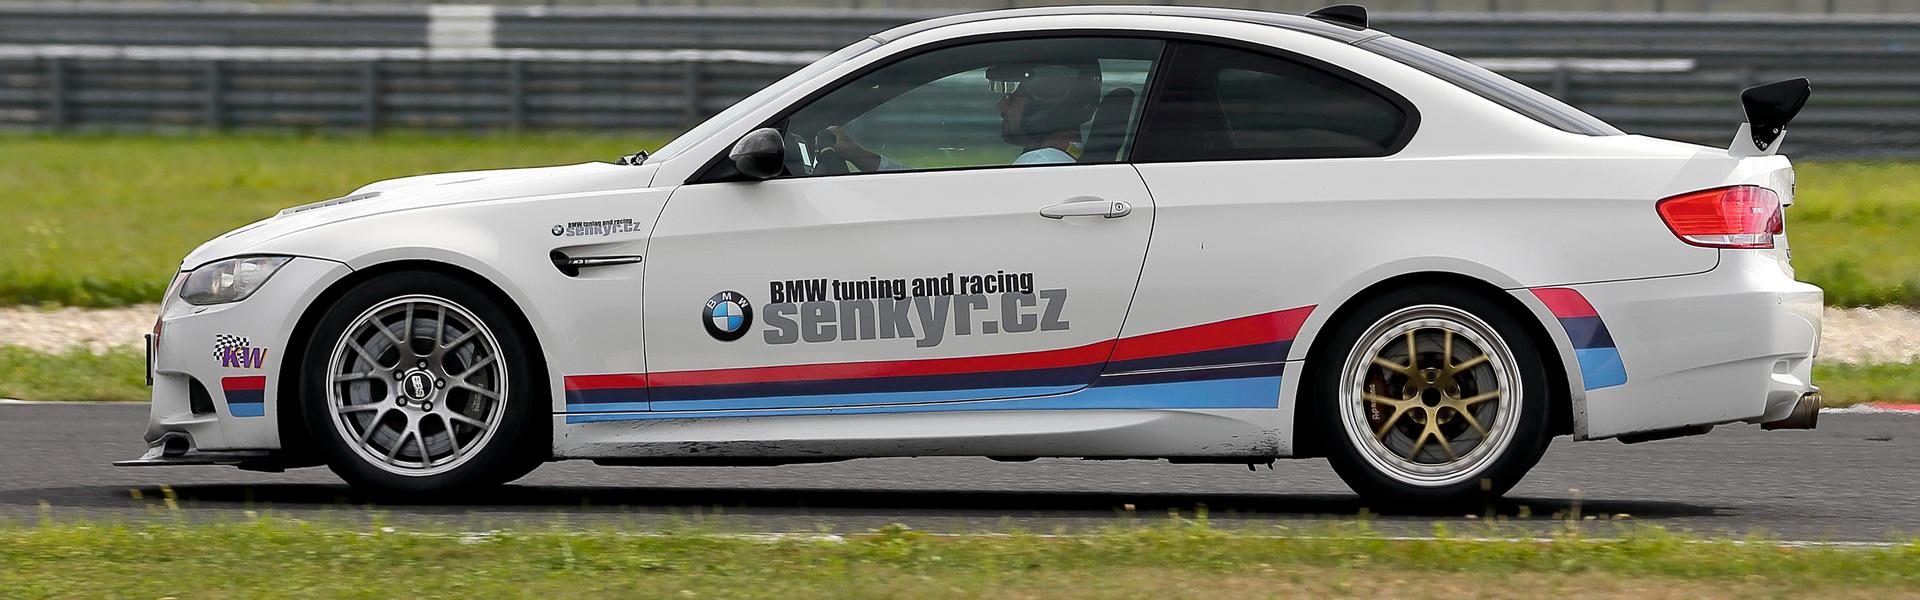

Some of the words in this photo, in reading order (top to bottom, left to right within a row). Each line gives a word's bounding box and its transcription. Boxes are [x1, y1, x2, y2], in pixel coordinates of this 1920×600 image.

[566, 221, 641, 237] senkyr.cz
[769, 278, 828, 304] BMW
[832, 276, 907, 301] tuning
[911, 272, 954, 297] and
[959, 270, 1034, 294] racing
[706, 292, 749, 309] BMW
[762, 288, 1070, 349] senkyr.cz
[222, 346, 268, 369] KW
